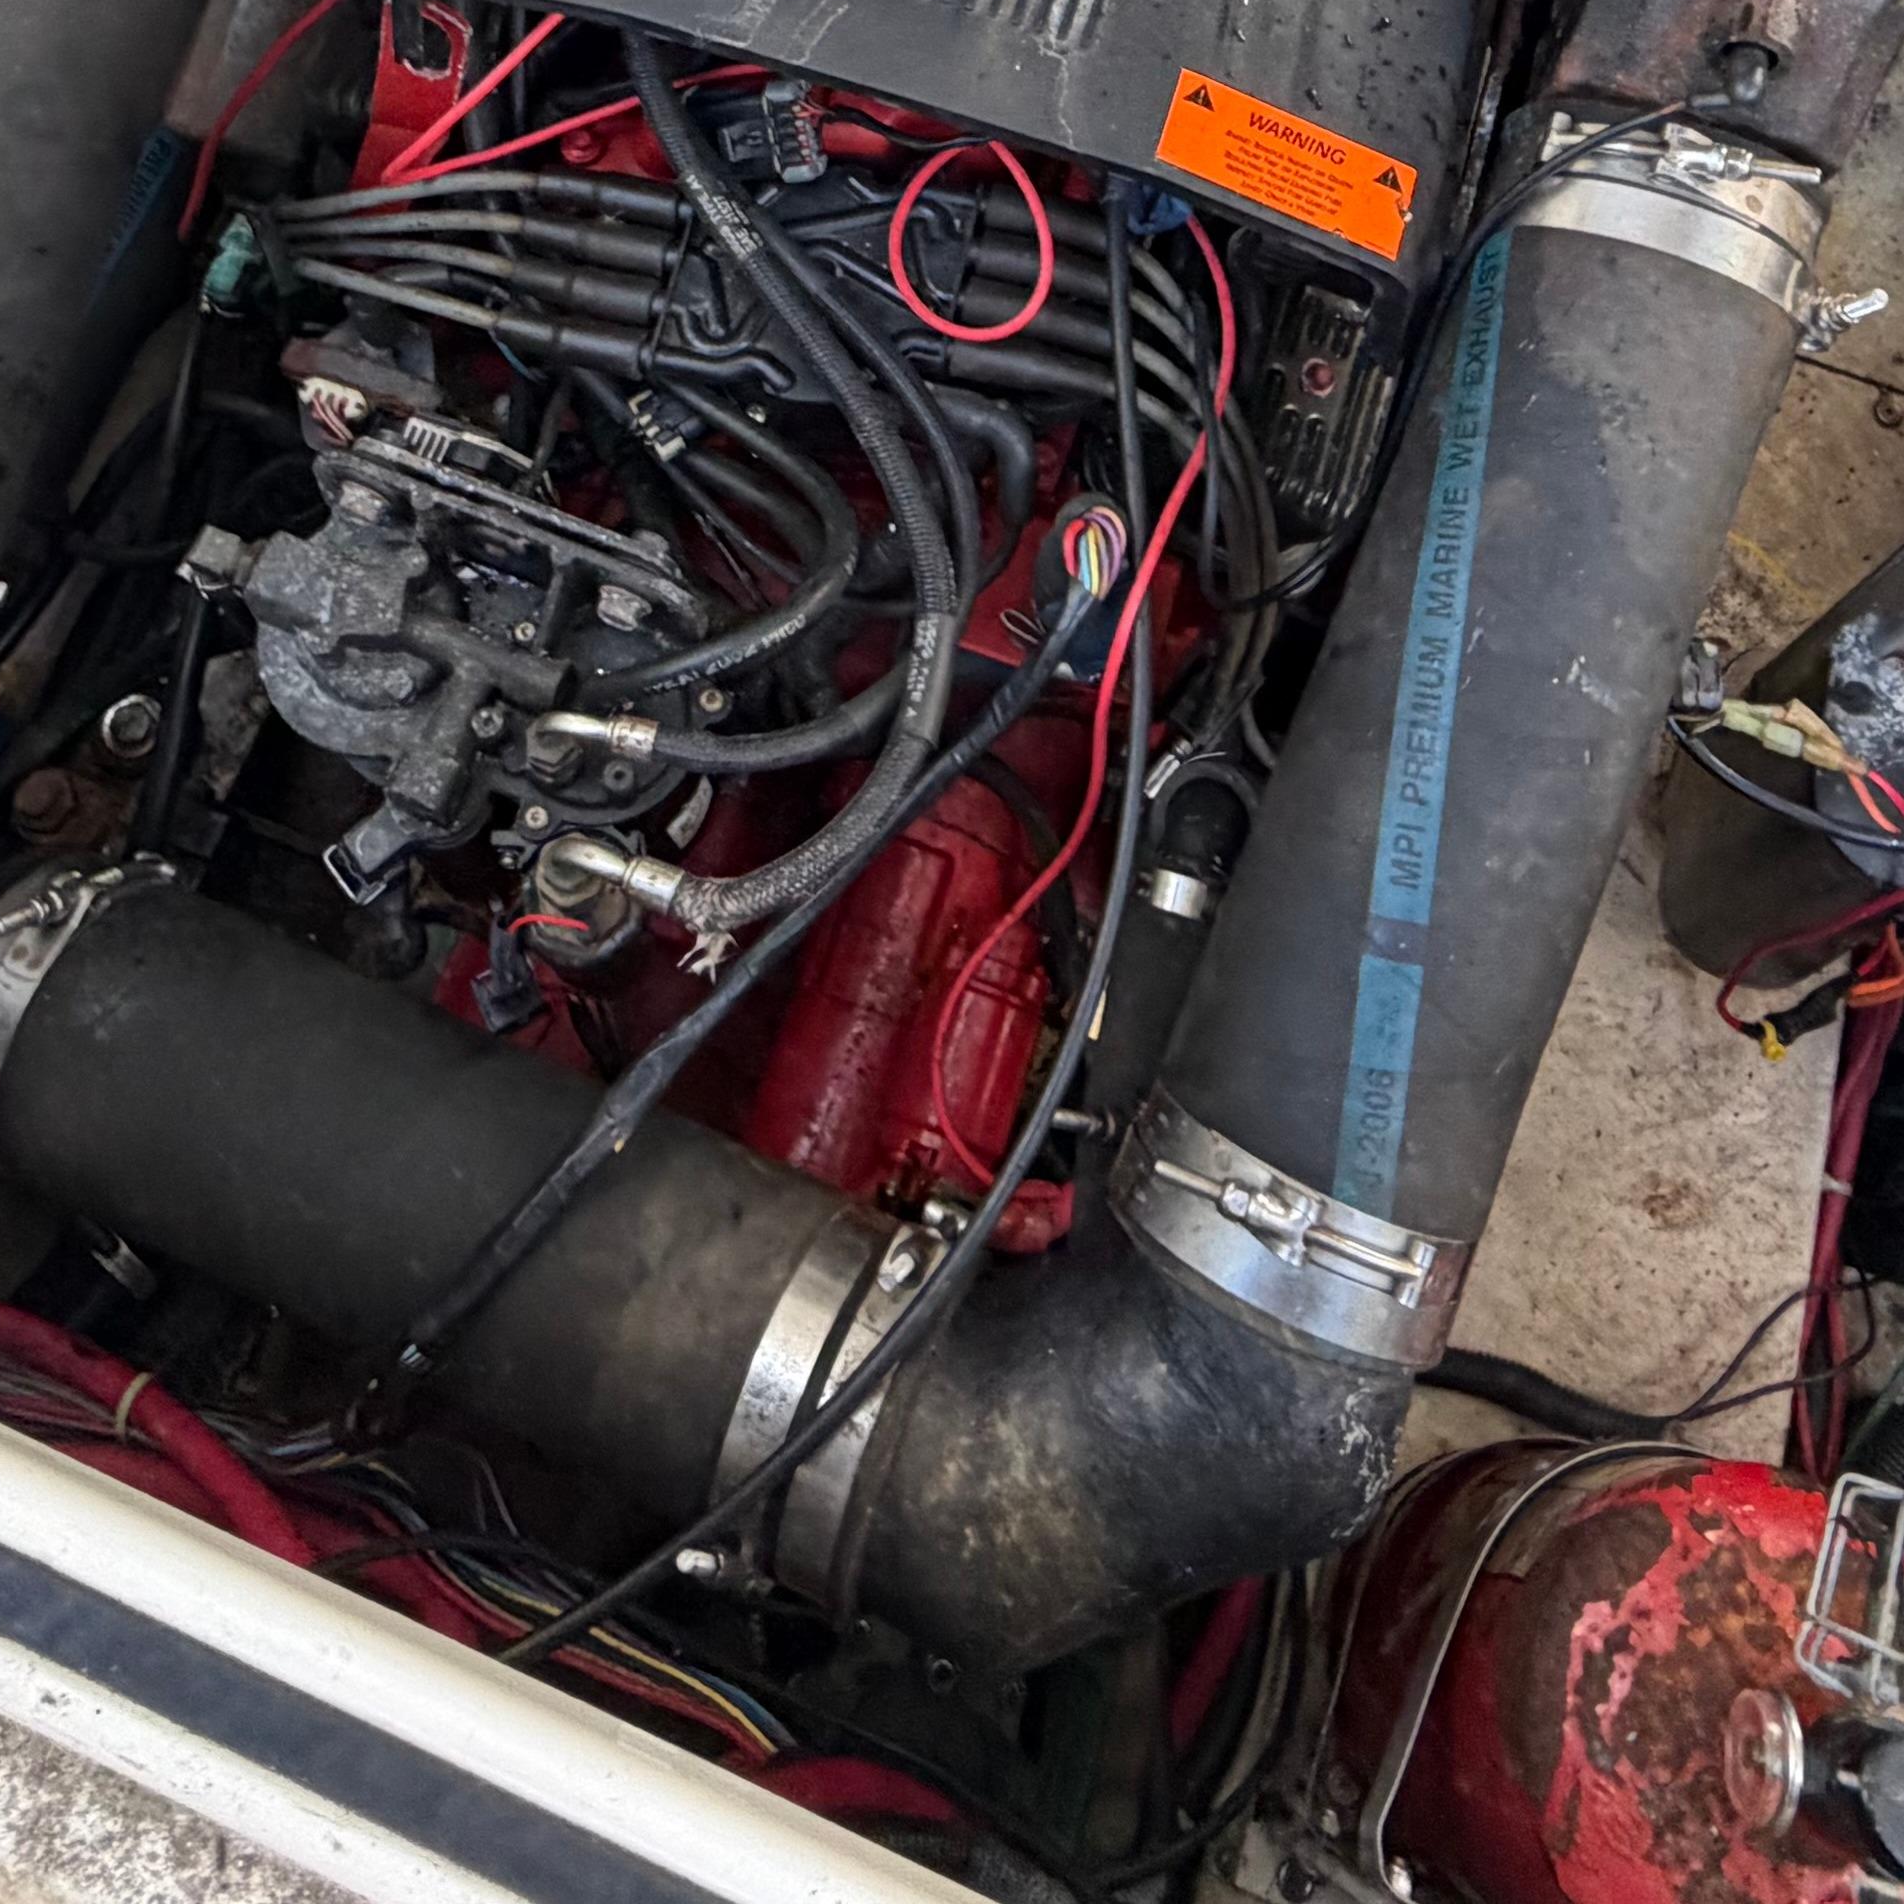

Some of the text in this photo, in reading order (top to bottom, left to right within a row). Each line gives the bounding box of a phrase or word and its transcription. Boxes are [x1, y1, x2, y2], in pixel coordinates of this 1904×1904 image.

[1248, 111, 1347, 166] WARNING
[1390, 248, 1502, 893] MPI PREMIUM MARINE WET EXHAUST
